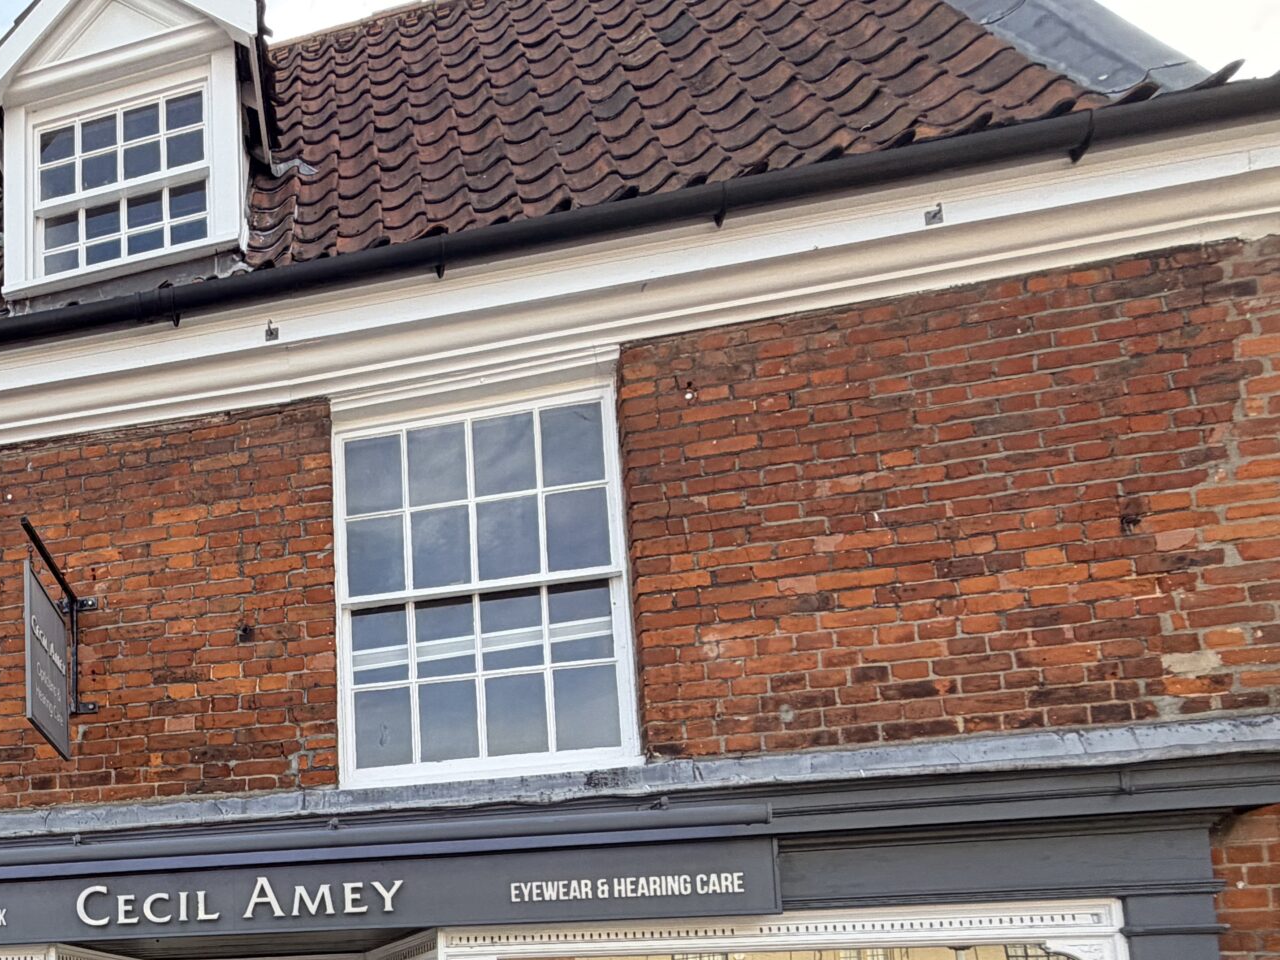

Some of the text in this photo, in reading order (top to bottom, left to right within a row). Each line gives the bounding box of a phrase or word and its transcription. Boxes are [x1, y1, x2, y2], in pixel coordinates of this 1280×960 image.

[31, 615, 49, 653] CECIL
[76, 876, 404, 926] CECIL AMEY
[510, 872, 745, 902] EYEWEAR & HEARING CARE
